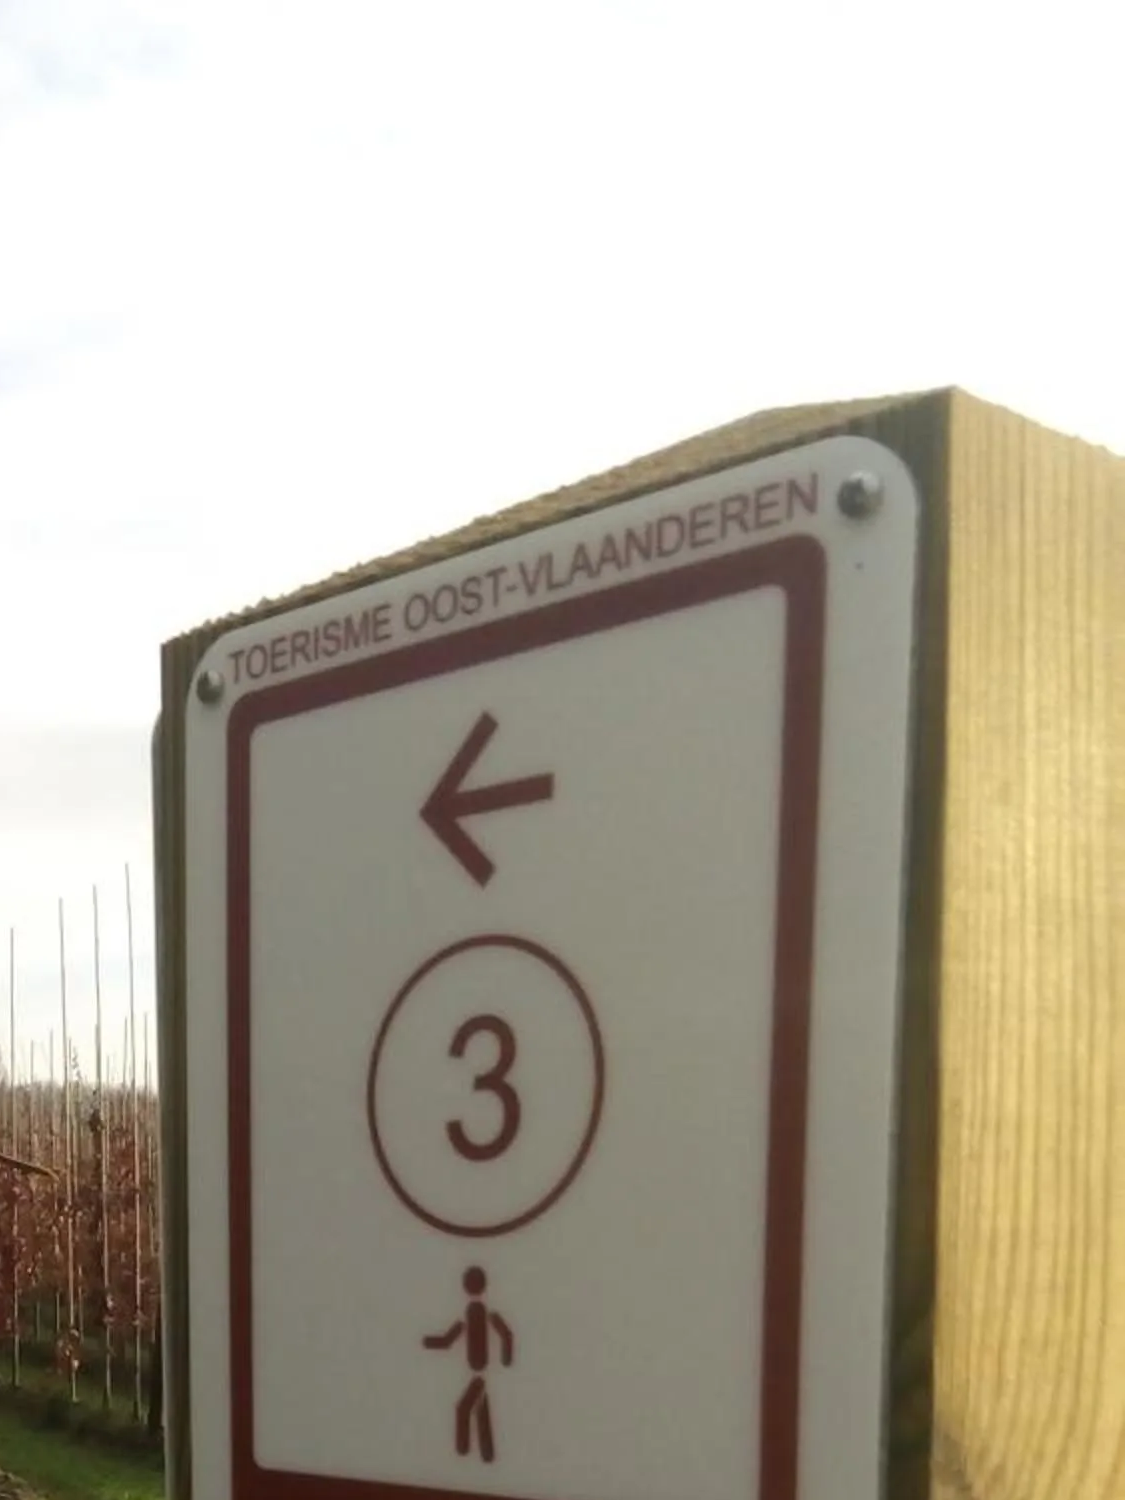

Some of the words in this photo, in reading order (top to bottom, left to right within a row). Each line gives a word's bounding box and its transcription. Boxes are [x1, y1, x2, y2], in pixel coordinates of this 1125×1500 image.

[228, 601, 392, 685] TOERISME
[404, 472, 819, 632] OOST-VLAANDEREN
[446, 1013, 521, 1163] 3
